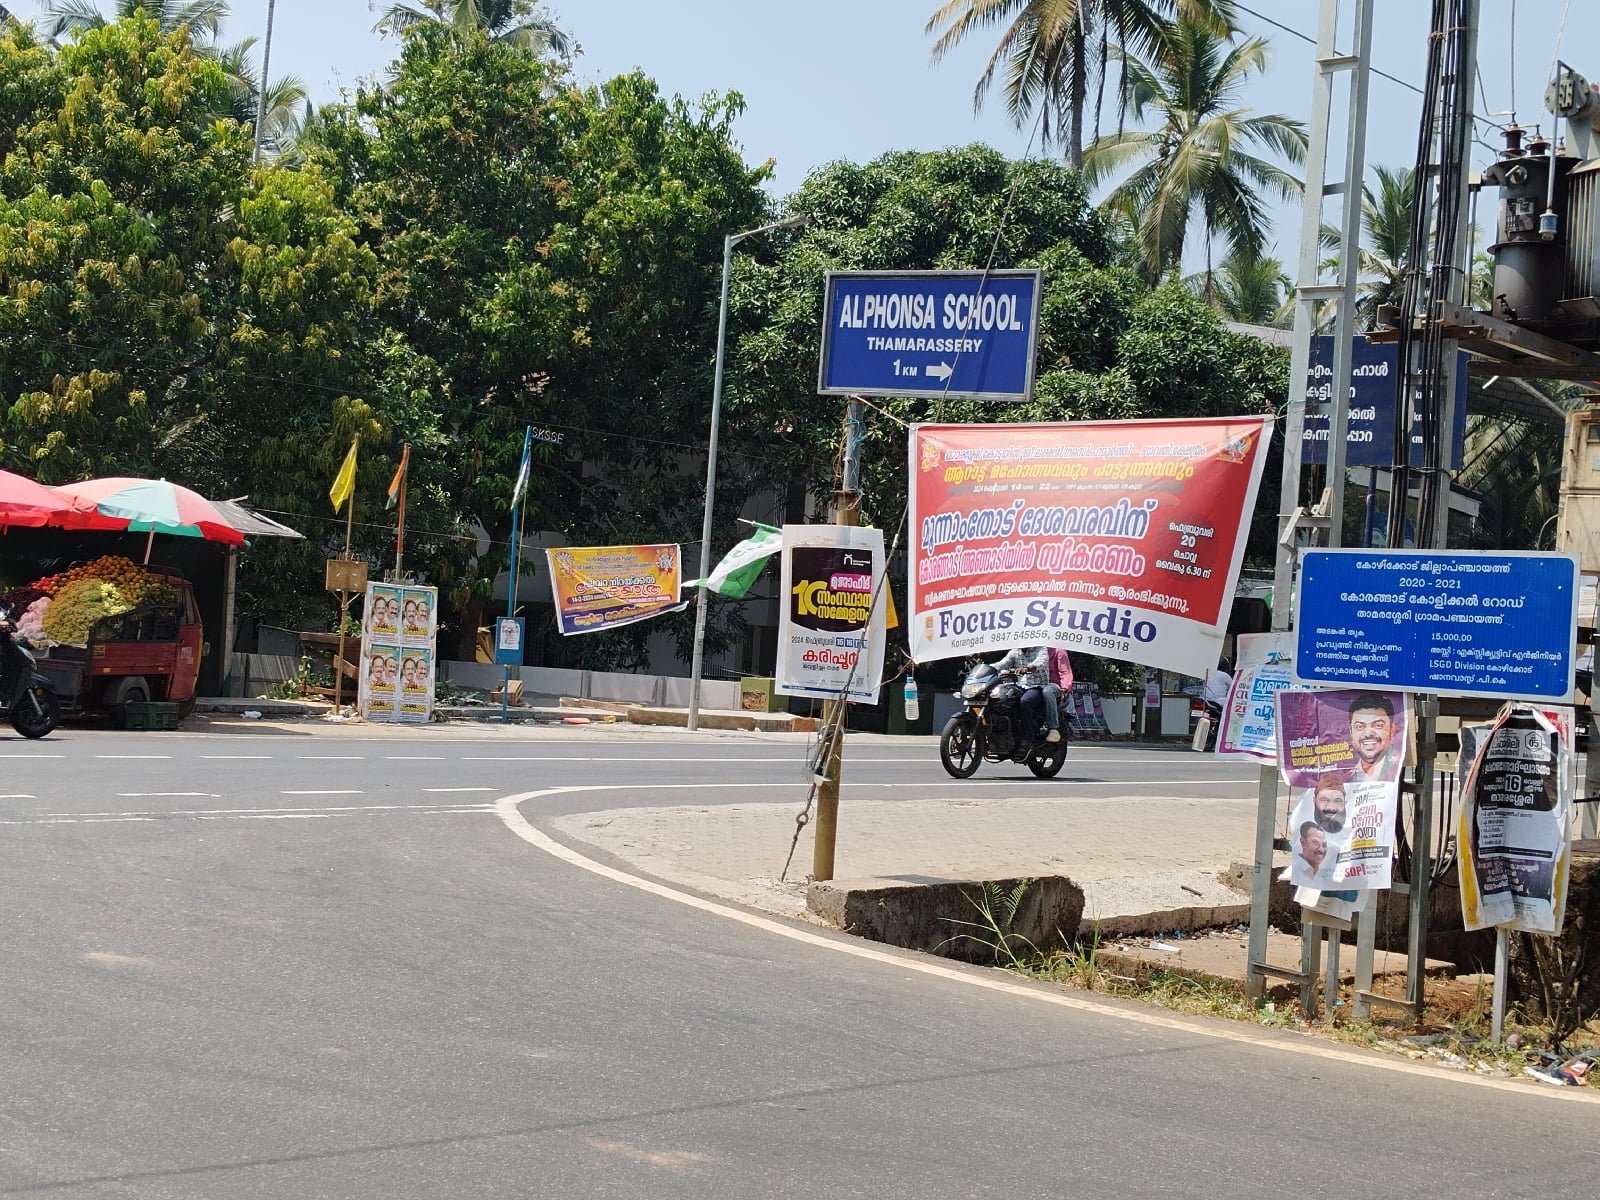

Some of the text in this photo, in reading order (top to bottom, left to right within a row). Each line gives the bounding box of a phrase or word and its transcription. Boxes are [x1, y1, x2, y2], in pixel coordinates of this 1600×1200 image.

[840, 293, 1020, 331] ALPHONSA SCHOOL
[867, 336, 982, 352] THAMARASSERY
[893, 358, 918, 376] 1 KM
[944, 462, 991, 484] ആറാട്ട്
[1019, 498, 1158, 539] ദേശവരവിന്
[1180, 534, 1196, 548] 20
[1038, 537, 1145, 577] സ്വീകരണം
[1186, 565, 1202, 578] 6.30
[1356, 560, 1512, 574] കോഴിക്കോട് ജില്ലാപഞ്ചായത്ത്
[1068, 580, 1105, 596] നിന്നും
[1400, 578, 1426, 588] 2020
[1435, 579, 1461, 589] 2021
[1340, 592, 1526, 610] കോരങ്ങാട് കോളിക്കൽ റോഡ്
[939, 600, 1157, 643] Focus Studio
[1357, 610, 1504, 624] താമരശ്ശേരി ഗ്രാമപഞ്ചായത്ത്
[952, 634, 984, 648] Korangad
[991, 632, 1011, 642] 9847
[1054, 632, 1083, 643] 9809
[1087, 636, 1130, 652] 189918
[1430, 660, 1533, 674] LSGD Division കോഴിക്കോട്
[1529, 739, 1539, 748] 05
[1506, 775, 1521, 791] 16
